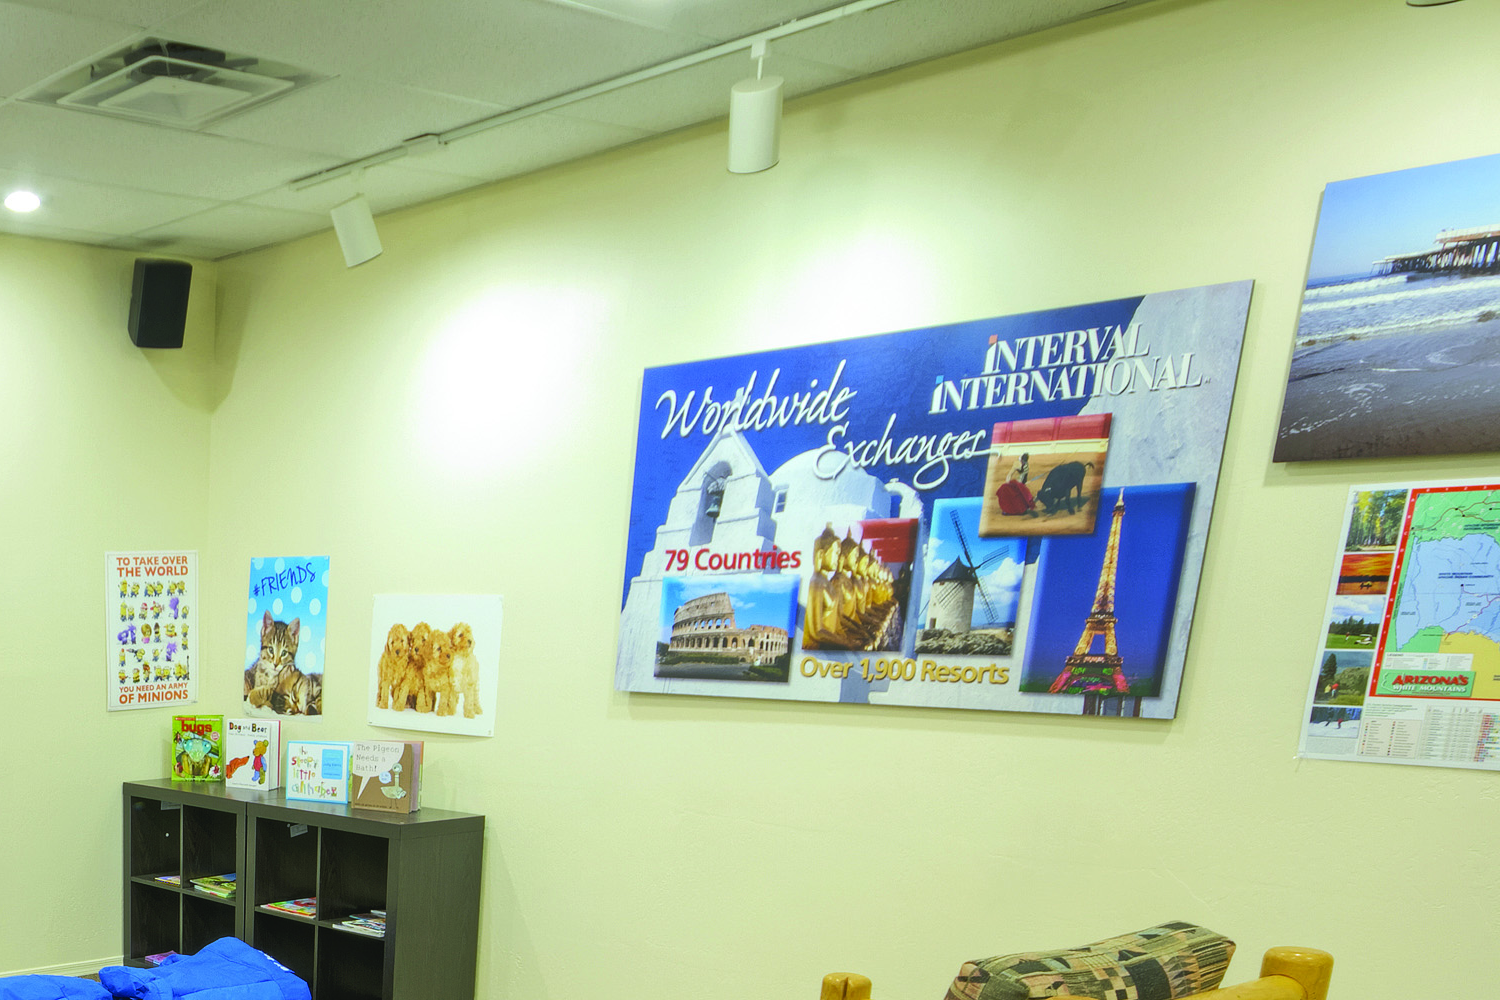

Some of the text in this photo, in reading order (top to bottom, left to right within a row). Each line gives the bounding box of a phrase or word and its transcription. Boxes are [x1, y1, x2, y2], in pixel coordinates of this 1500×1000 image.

[981, 322, 1150, 376] INTERVAL
[928, 352, 1203, 415] INTERNATIONAL
[655, 359, 858, 439] Worldwide
[813, 413, 1000, 490] Exchanges
[116, 556, 188, 566] TO TAKE OVER
[665, 545, 801, 572] 79 Countries
[117, 566, 188, 577] THE WORLD
[253, 562, 316, 597] #FRIENDS
[800, 657, 1009, 684] Over 1,900 Resorts
[1392, 674, 1469, 686] ARIZONA'S
[136, 684, 154, 692] NEED
[1392, 684, 1416, 692] WHITE
[1419, 685, 1467, 693] MOUNTAINS
[119, 690, 188, 704] OF MINIONS
[181, 720, 212, 736] bugs
[229, 722, 242, 733] Dog
[252, 723, 267, 733] Bear
[373, 744, 399, 753] Pigeon
[356, 754, 379, 762] Needs
[356, 764, 377, 772] Bath!
